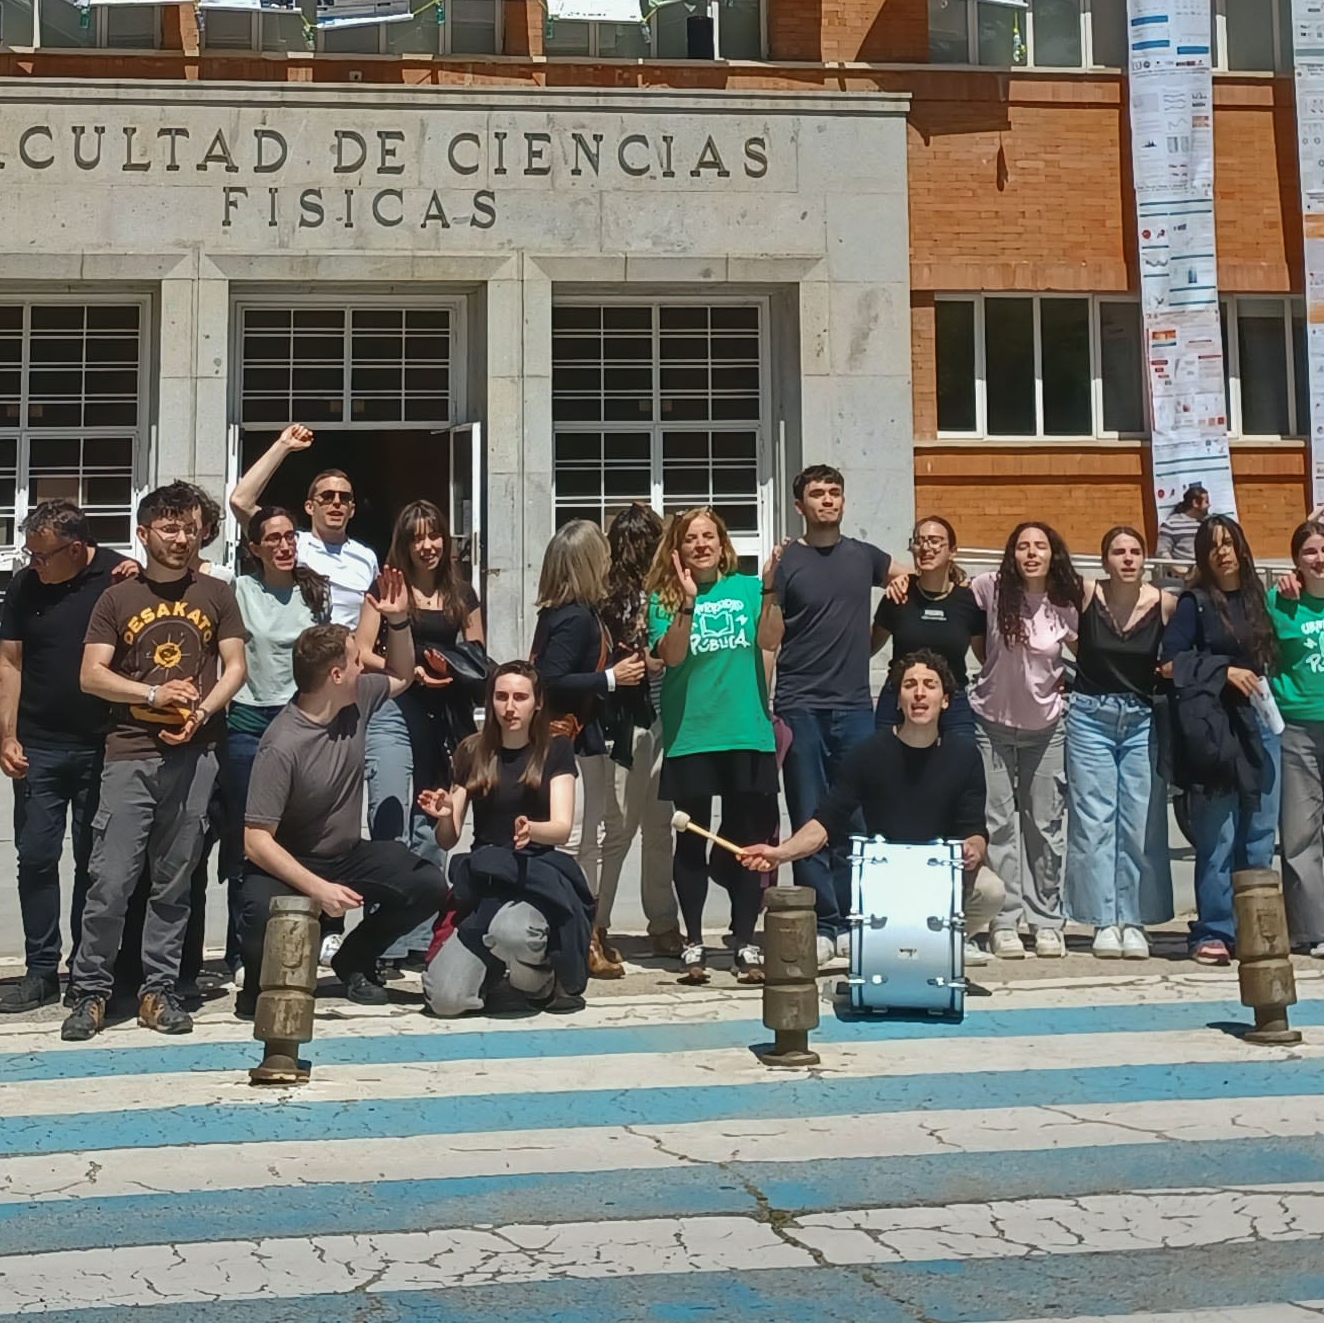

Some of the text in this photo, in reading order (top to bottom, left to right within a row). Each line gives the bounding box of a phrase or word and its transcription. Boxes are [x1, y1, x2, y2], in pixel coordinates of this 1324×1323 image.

[333, 130, 406, 176] DE
[447, 131, 770, 179] CIENCIAS
[222, 186, 497, 229] FISICAS
[123, 601, 213, 646] DESAKATO
